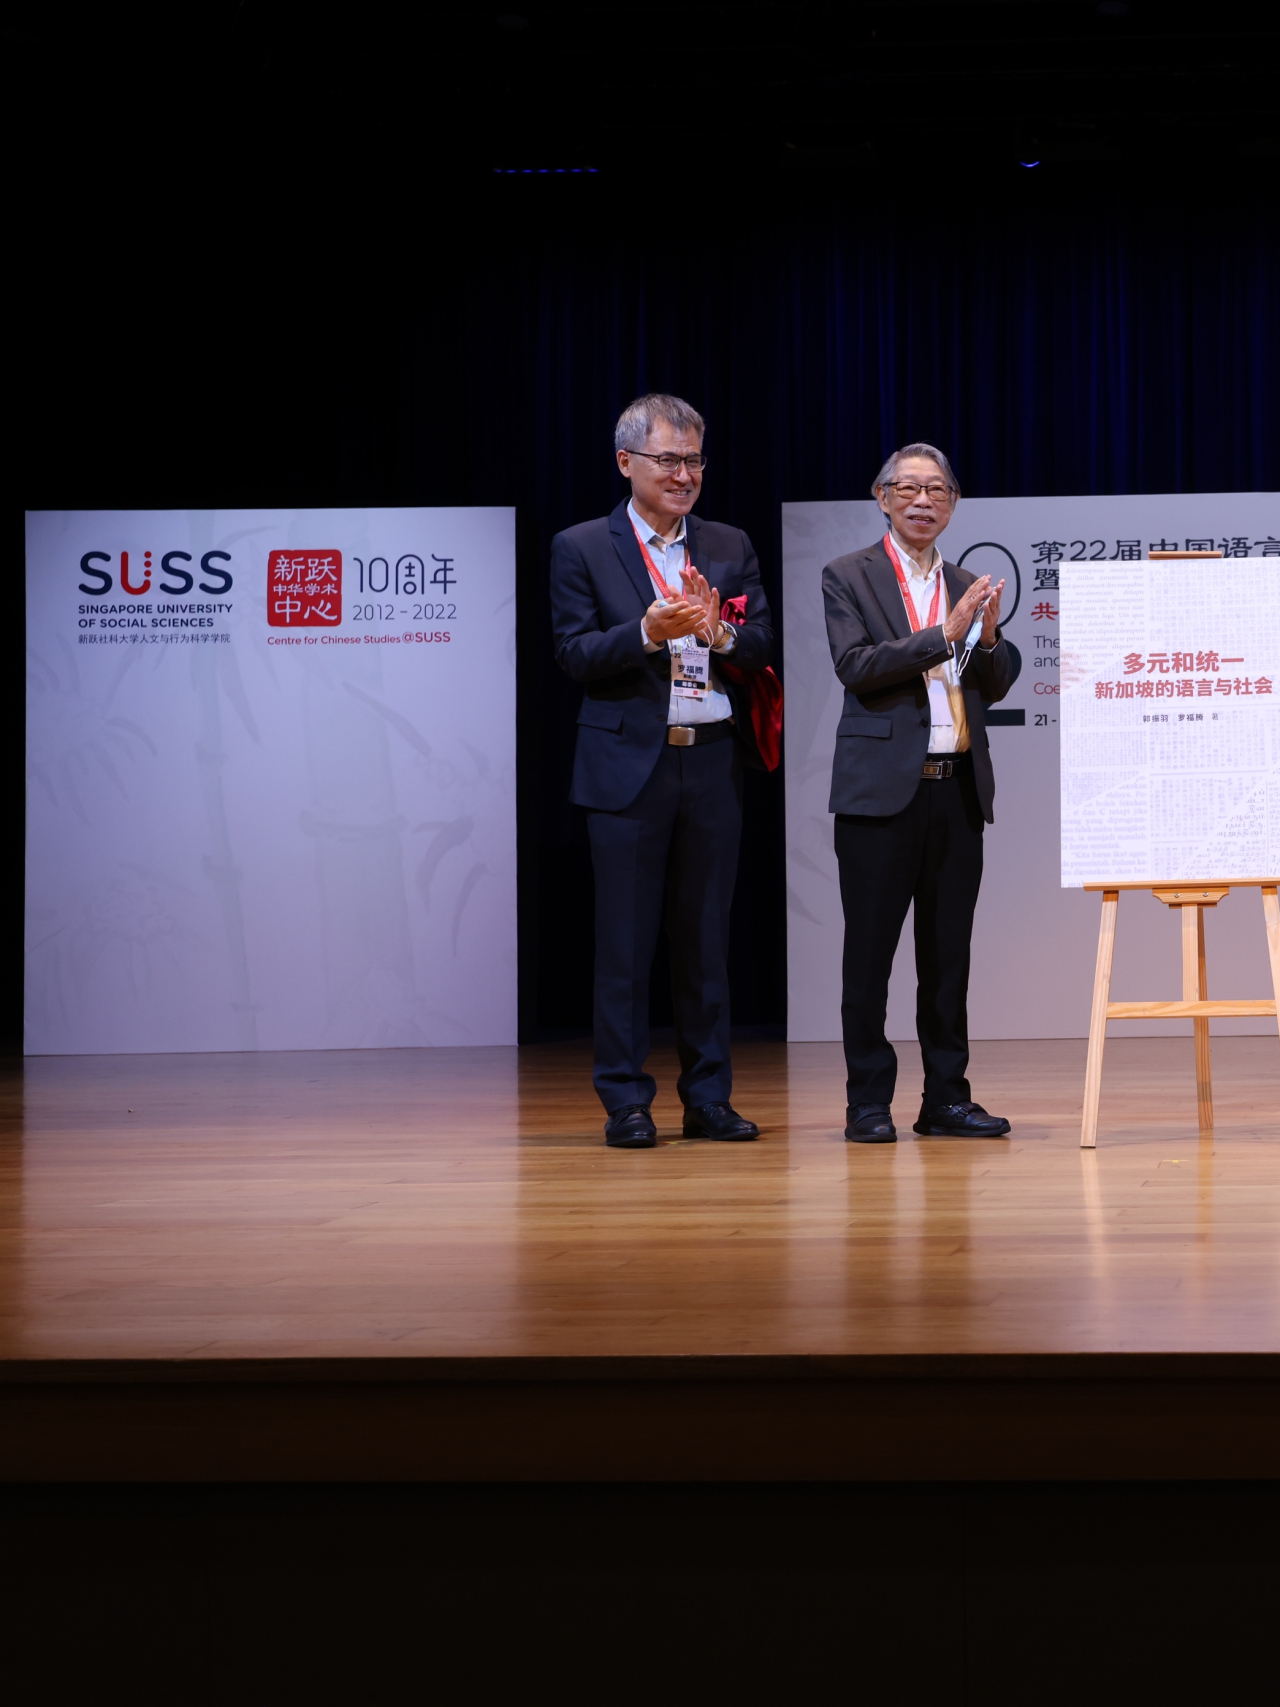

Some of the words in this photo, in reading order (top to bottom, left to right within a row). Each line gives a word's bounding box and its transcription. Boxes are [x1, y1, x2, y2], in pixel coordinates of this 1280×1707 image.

[78, 550, 233, 596] SUSS
[273, 555, 338, 582] 新跃
[353, 553, 457, 595] 10周年
[273, 583, 338, 597] 中华学术
[78, 604, 153, 614] SINGAPORE
[157, 603, 233, 614] UNIVERSITY
[274, 596, 338, 624] 中心
[352, 604, 395, 621] 2012
[412, 603, 457, 620] 2022
[78, 618, 96, 628] OF
[100, 618, 147, 628] SOCIAL
[151, 617, 214, 627] SCIENCES
[267, 636, 302, 645] Centre
[304, 635, 318, 644] for
[321, 635, 361, 644] Chinese
[364, 634, 401, 644] Studies
[1123, 650, 1245, 675] 多元和统一
[1094, 676, 1273, 700] 新加坡的语言与社会
[1034, 714, 1048, 727] 21
